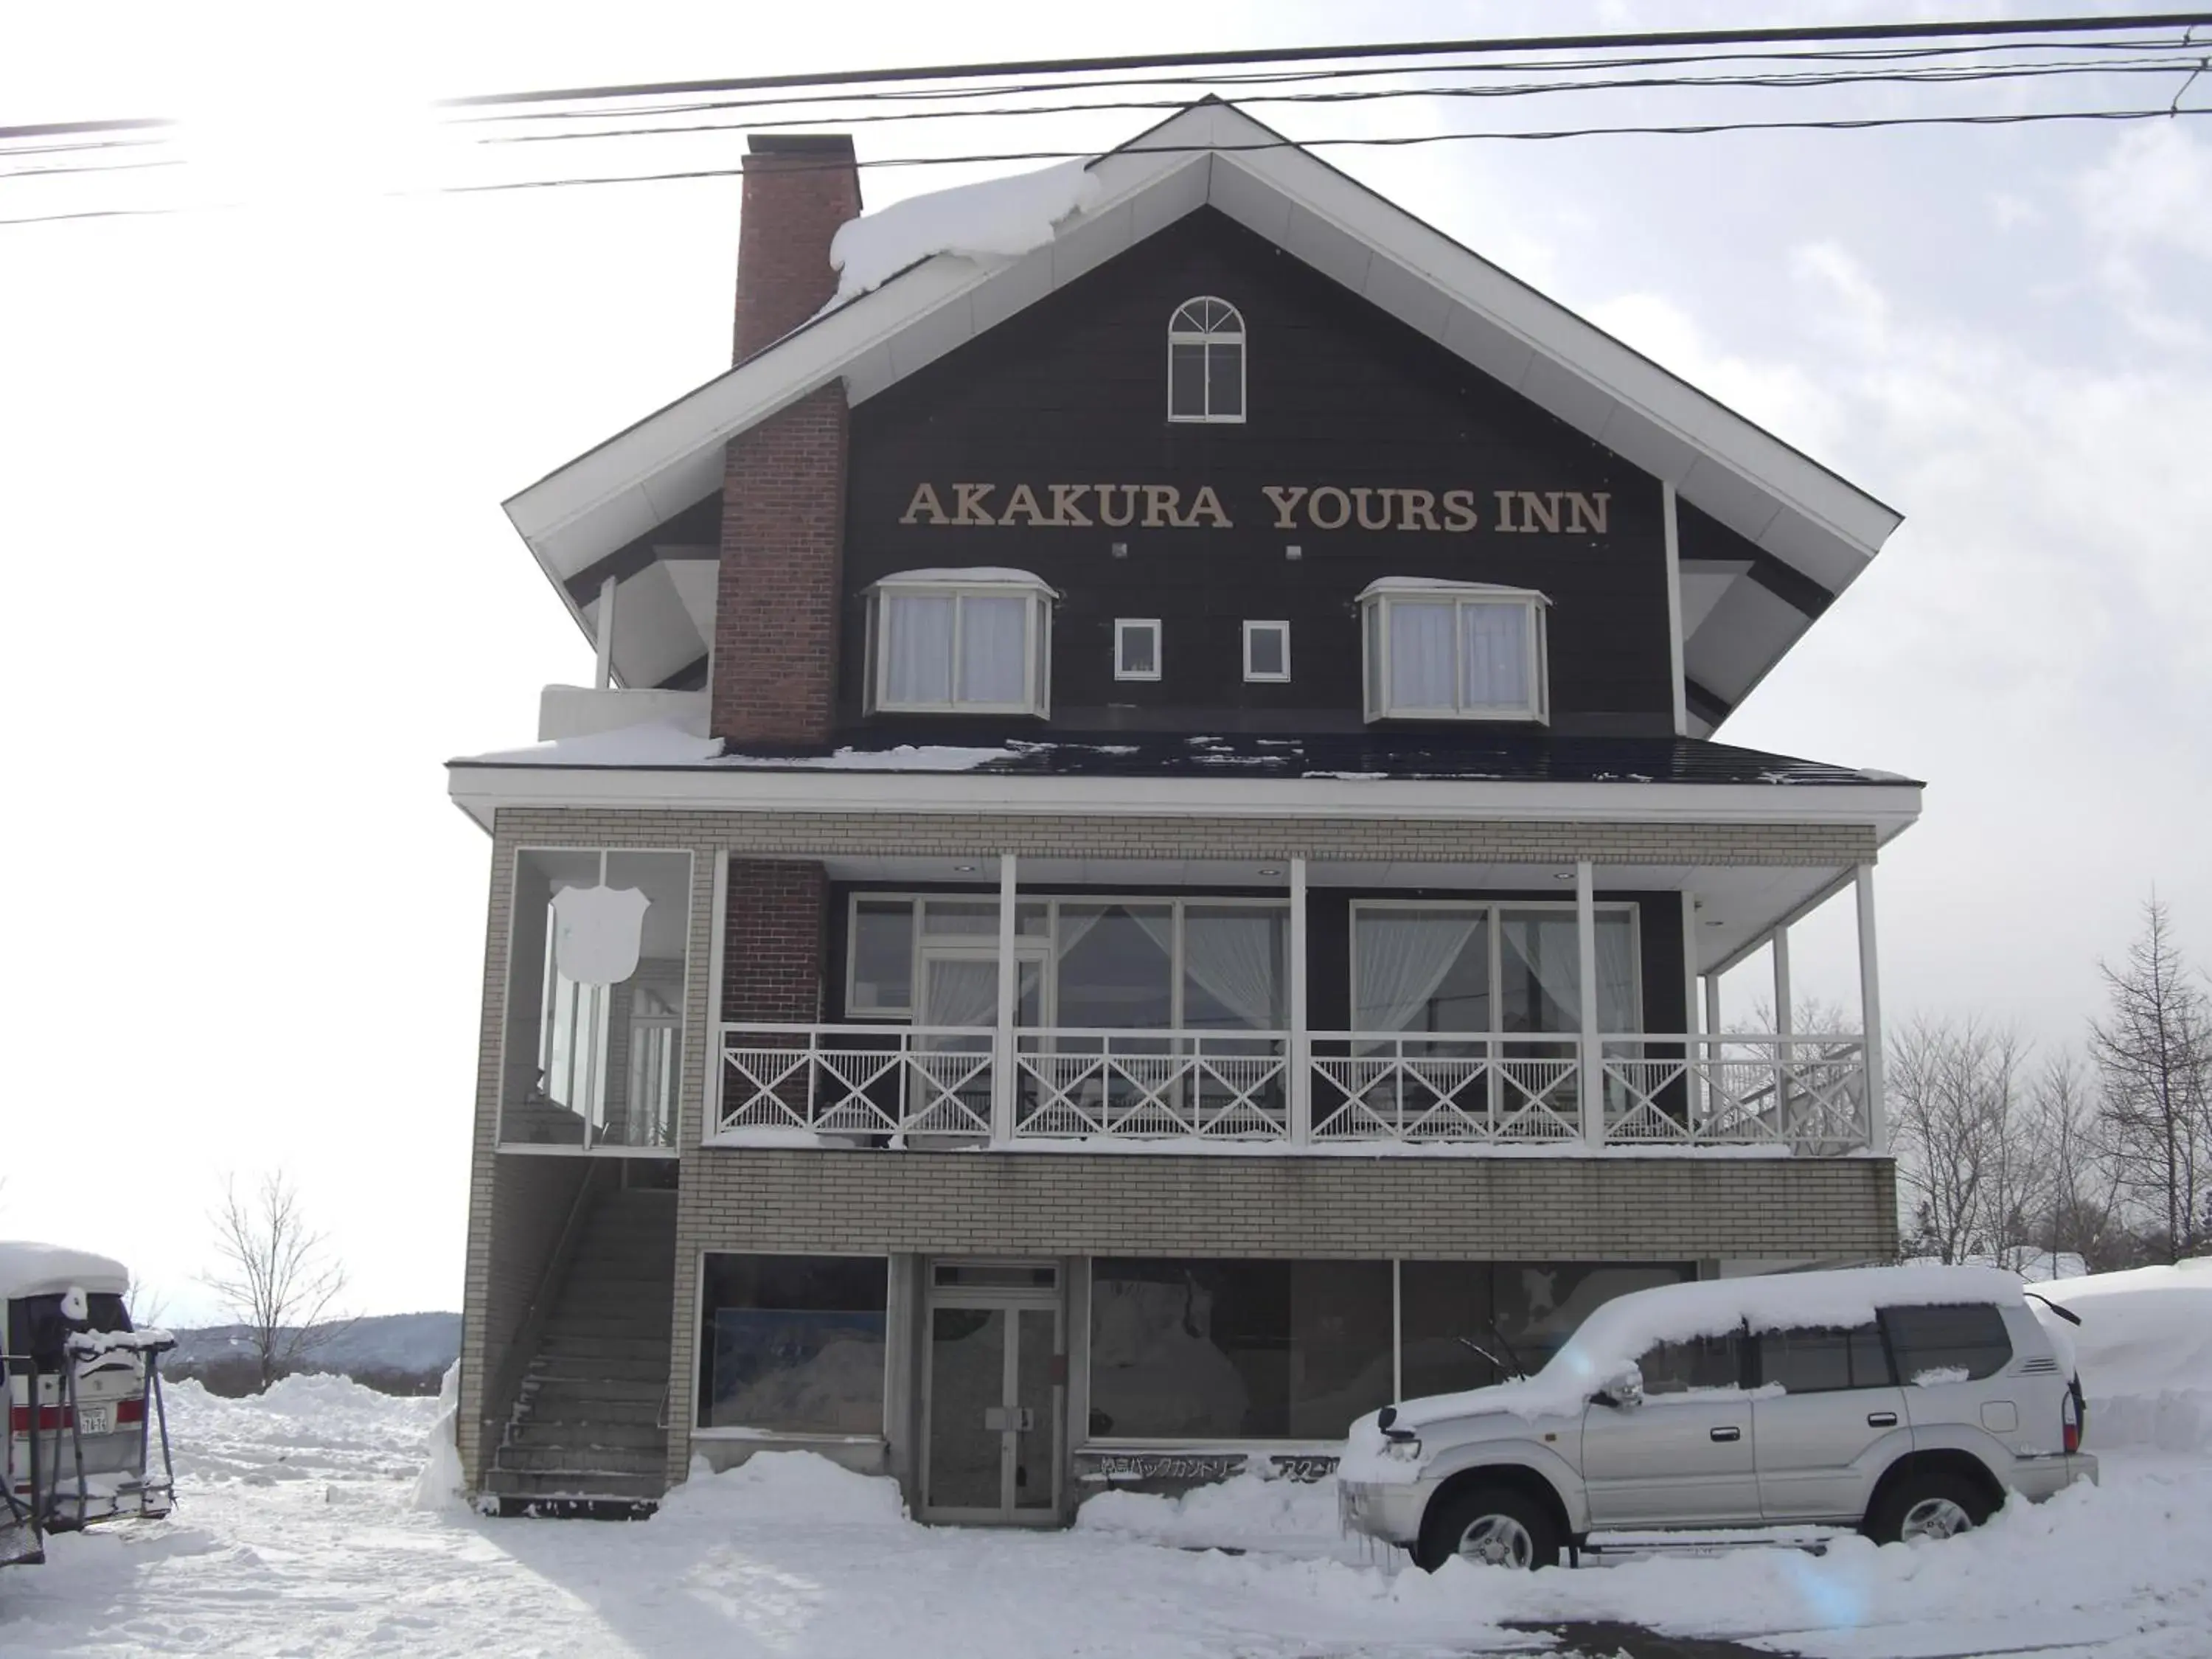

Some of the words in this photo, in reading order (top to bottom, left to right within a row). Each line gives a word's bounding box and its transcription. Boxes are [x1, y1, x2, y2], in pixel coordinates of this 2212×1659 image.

[898, 482, 1234, 529] AKAKURA
[1262, 486, 1478, 532] YOURS
[1493, 490, 1612, 534] INN
